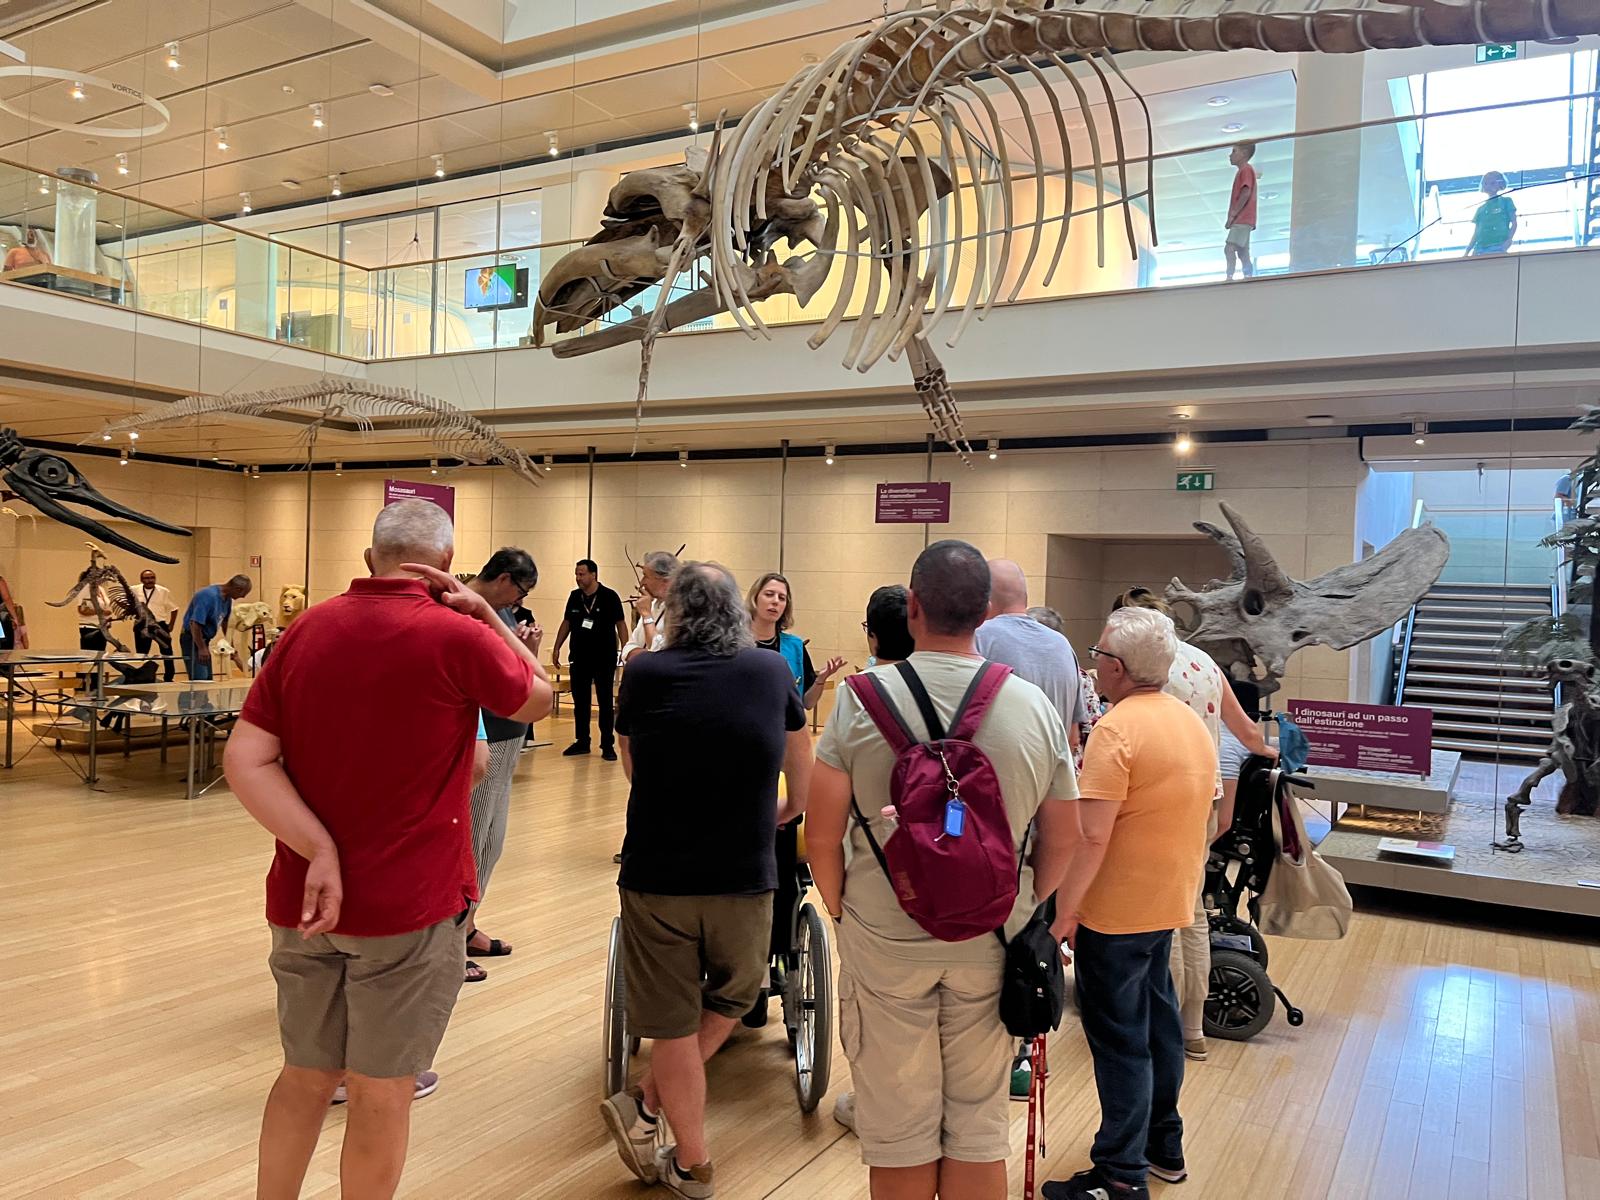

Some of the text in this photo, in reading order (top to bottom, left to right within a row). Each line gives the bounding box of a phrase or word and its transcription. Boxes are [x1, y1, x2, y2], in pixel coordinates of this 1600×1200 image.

[112, 82, 142, 99] VORTICE
[1295, 716, 1364, 728] dall'estinzione
[1300, 708, 1346, 719] dinosauri
[1347, 711, 1361, 720] ad
[1362, 713, 1376, 721] un
[1377, 714, 1409, 724] passo
